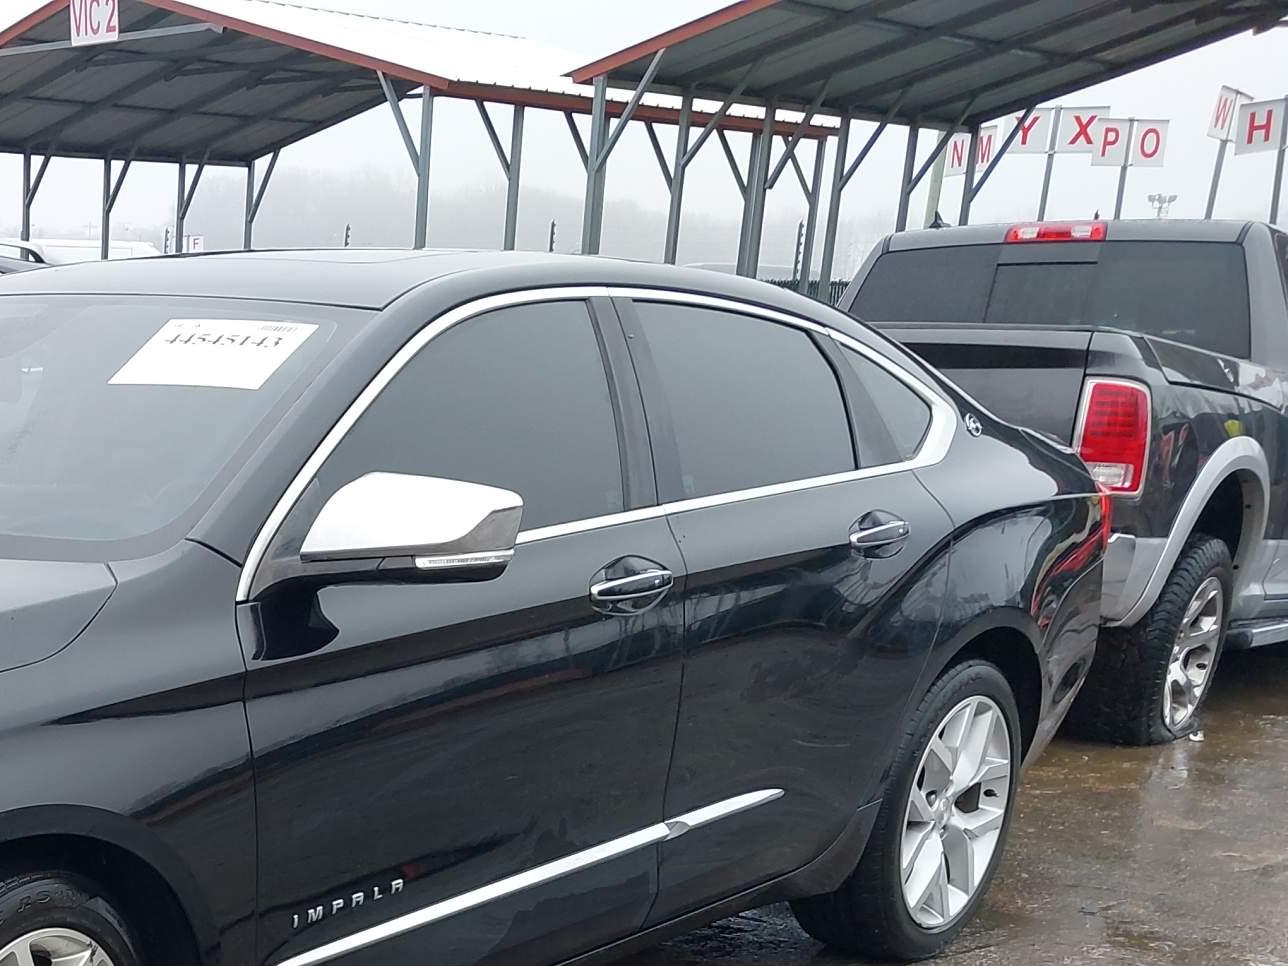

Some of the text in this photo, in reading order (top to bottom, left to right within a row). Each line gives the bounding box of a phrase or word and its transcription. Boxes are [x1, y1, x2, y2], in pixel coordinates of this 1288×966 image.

[72, 0, 116, 37] VIC 2
[1213, 95, 1234, 131] W
[1246, 108, 1273, 145] H
[1016, 115, 1041, 145] Y
[1068, 114, 1098, 145] X
[1100, 127, 1120, 157] P
[1140, 127, 1161, 158] O
[950, 139, 965, 169] N
[193, 237, 200, 249] F
[165, 333, 283, 348] 44545143
[292, 878, 404, 929] IMPALA
